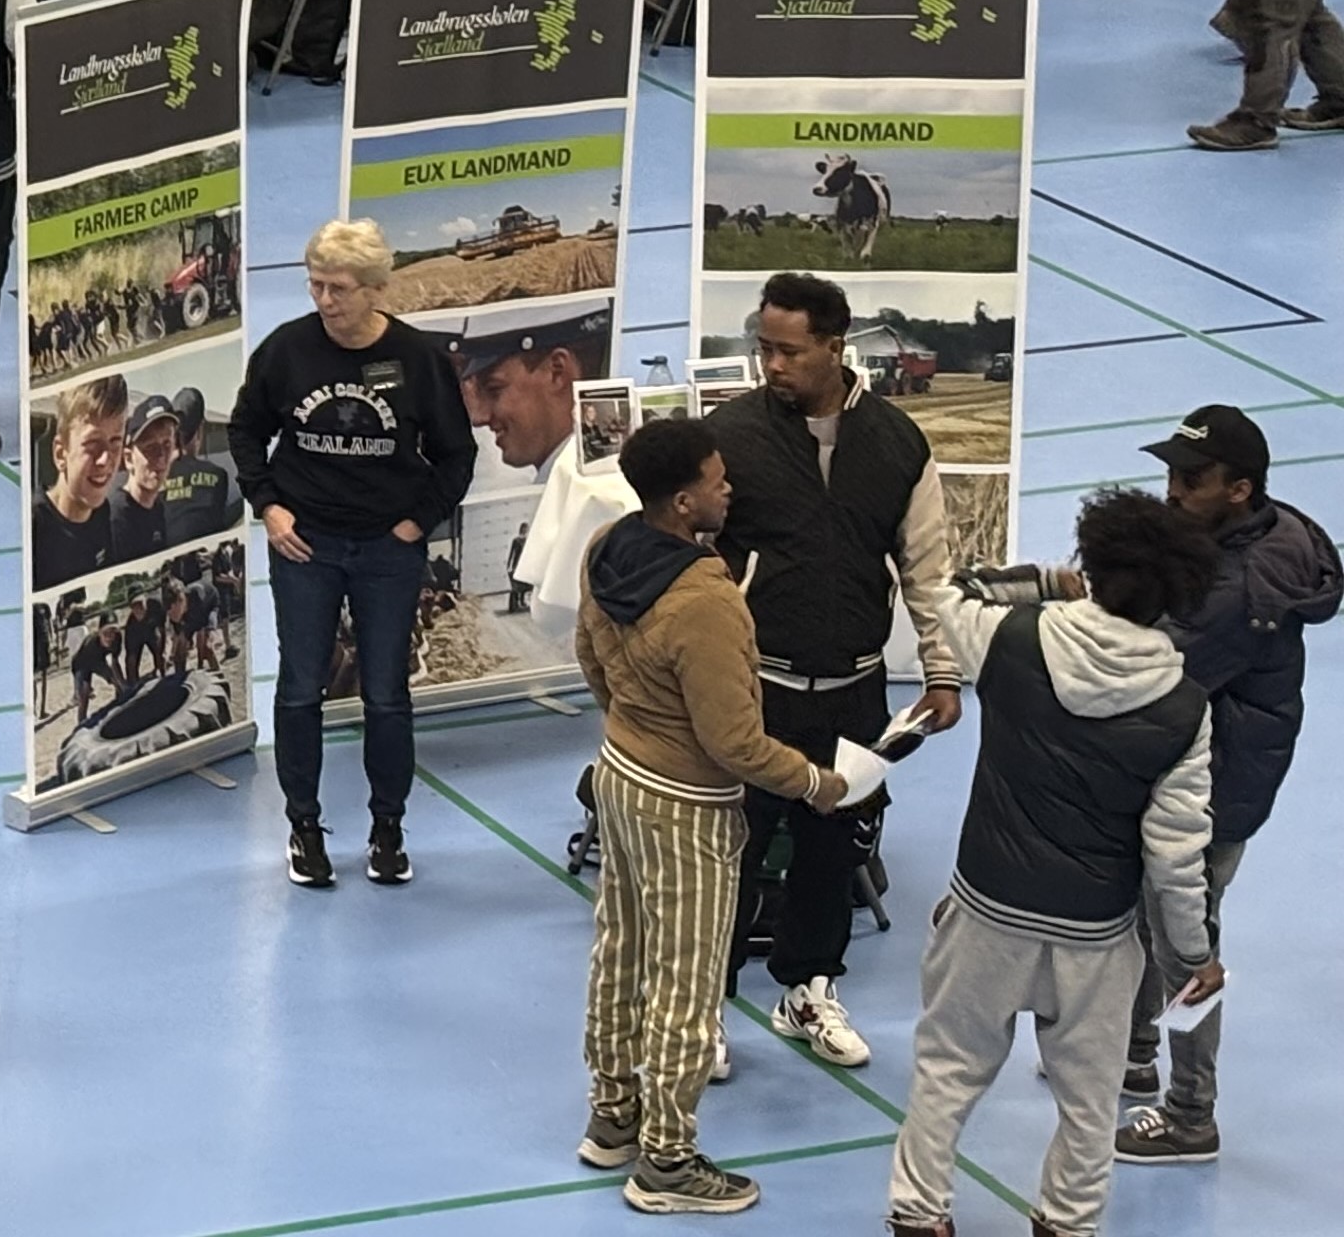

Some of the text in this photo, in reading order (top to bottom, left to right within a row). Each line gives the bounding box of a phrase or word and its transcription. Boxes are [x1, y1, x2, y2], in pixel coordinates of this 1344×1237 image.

[398, 2, 531, 40] Landbrugsskolen
[59, 42, 163, 86] Landbrugsskolen
[413, 31, 486, 63] Sjælland
[793, 120, 935, 143] LANDMAND
[403, 147, 573, 187] EUX LANDMAND
[73, 187, 200, 240] FARMER CAMP
[295, 430, 396, 456] ZEALAND
